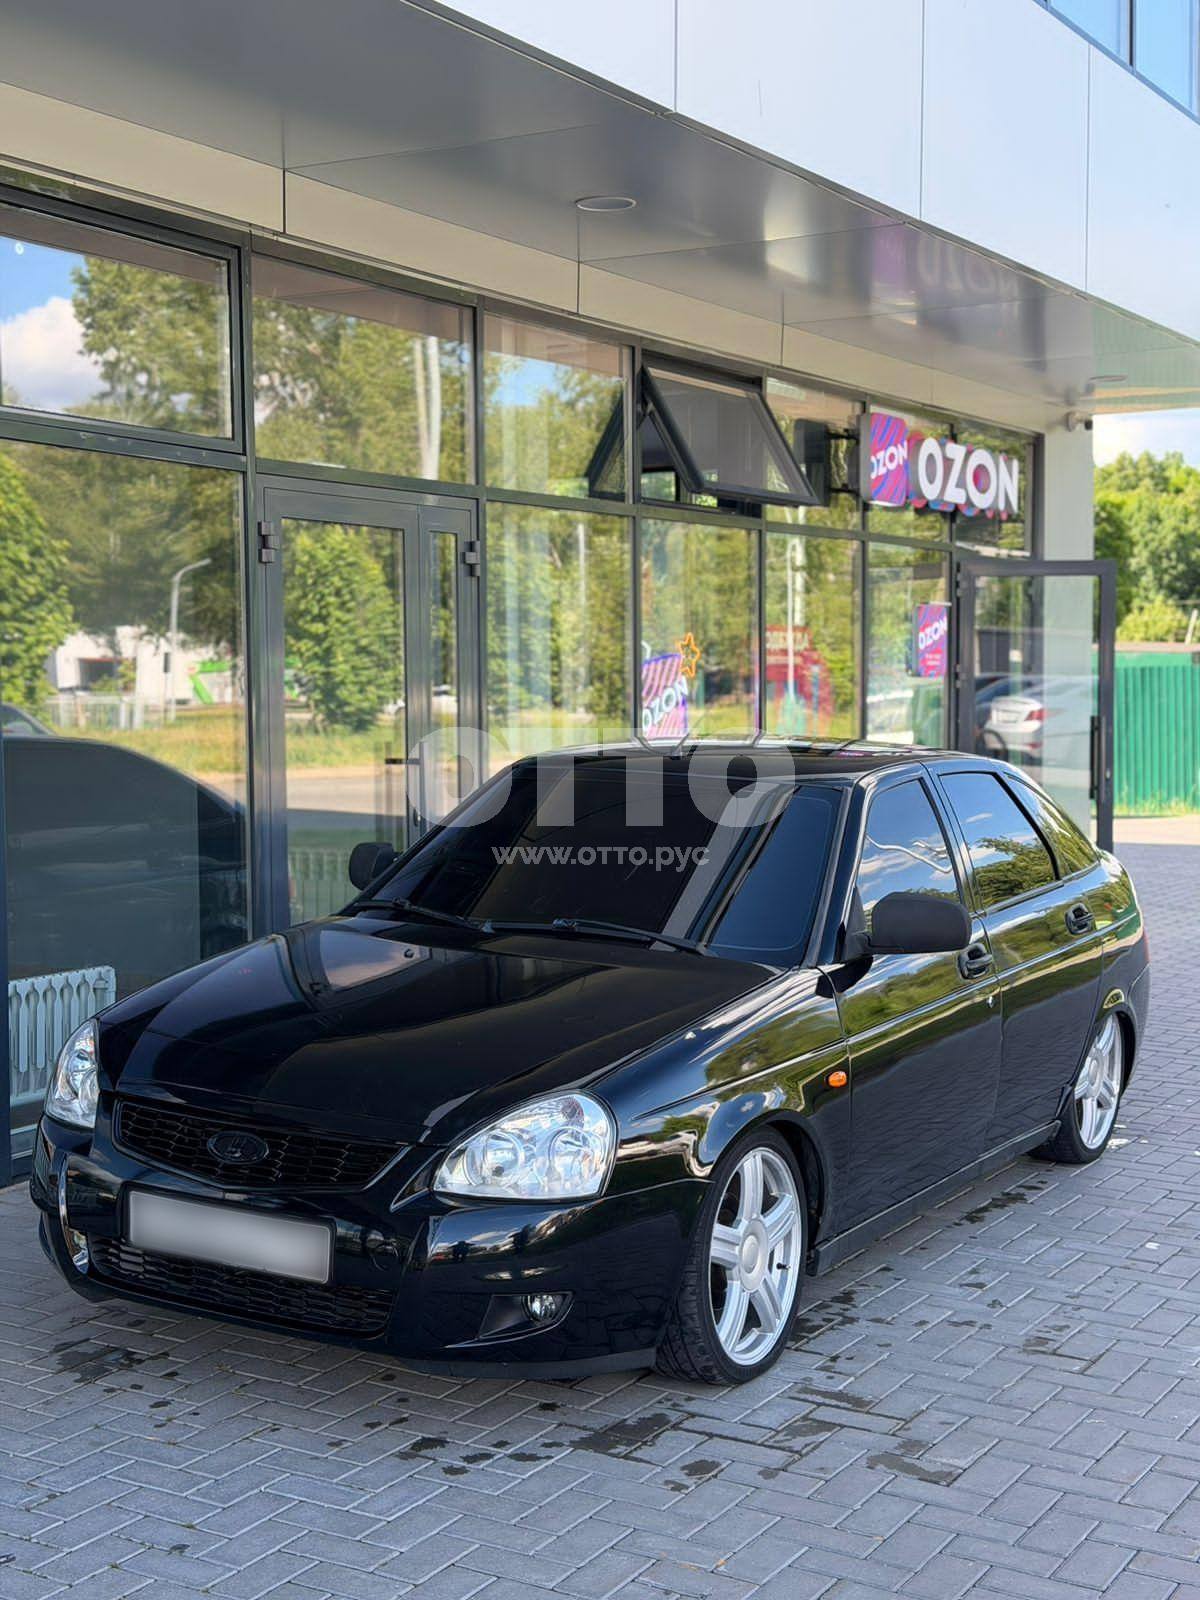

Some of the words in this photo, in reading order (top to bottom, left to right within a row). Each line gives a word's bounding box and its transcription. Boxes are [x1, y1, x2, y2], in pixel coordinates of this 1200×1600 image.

[918, 437, 1020, 514] OZON
[918, 616, 948, 650] OZON
[642, 675, 688, 733] OZON
